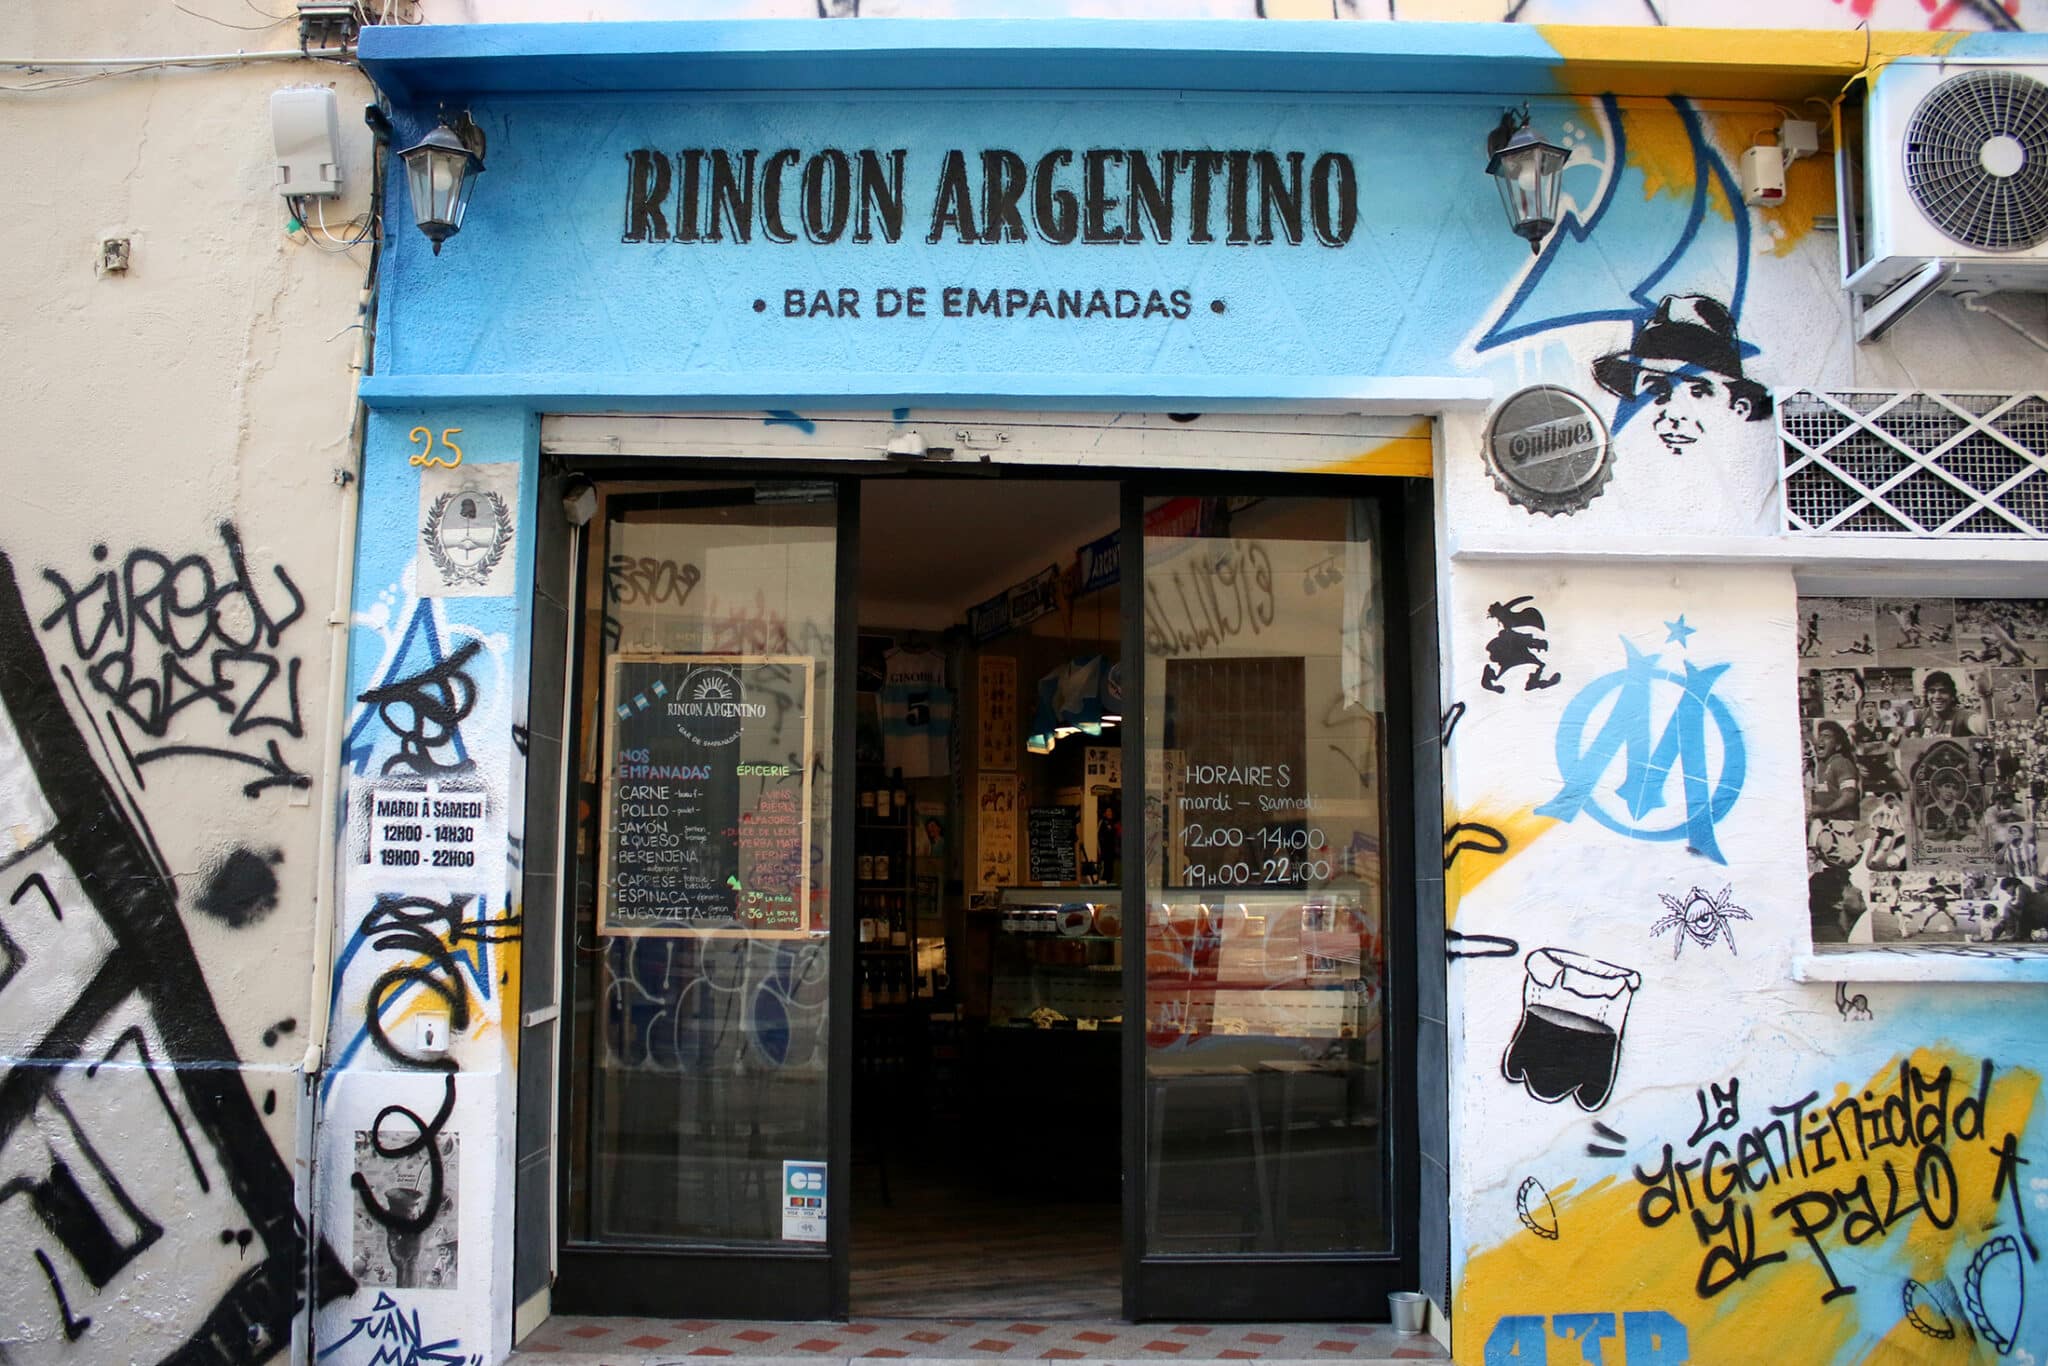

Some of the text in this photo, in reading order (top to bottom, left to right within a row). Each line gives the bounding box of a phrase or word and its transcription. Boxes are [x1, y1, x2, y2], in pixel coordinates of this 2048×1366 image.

[621, 148, 1359, 248] RINCON ARGENTINO
[783, 286, 1193, 319] BAR DE EMPANADAS
[408, 426, 463, 468] 25
[667, 702, 766, 718] RINCON ARGENTINO
[907, 692, 930, 726] 5
[618, 748, 650, 763] NOS
[619, 764, 712, 779] EMPANADAS
[736, 760, 790, 777] ÉPICERIE
[1186, 764, 1291, 788] HORAIRES
[619, 785, 670, 800] CARNE
[377, 797, 481, 818] MARDI À SAMEDI
[621, 803, 669, 817] POLLO
[1179, 792, 1232, 811] mardi
[383, 825, 422, 841] 12H00
[434, 826, 474, 842] 14H30
[618, 820, 669, 834] JAMÓN
[630, 833, 680, 849] QUESO
[381, 849, 421, 866] 19H00
[432, 850, 475, 867] 22H00
[618, 850, 699, 864] BERENJENA
[617, 871, 676, 888] CAPRESE
[618, 889, 690, 904] ESPINACA
[618, 906, 704, 920] FUGAZZETA
